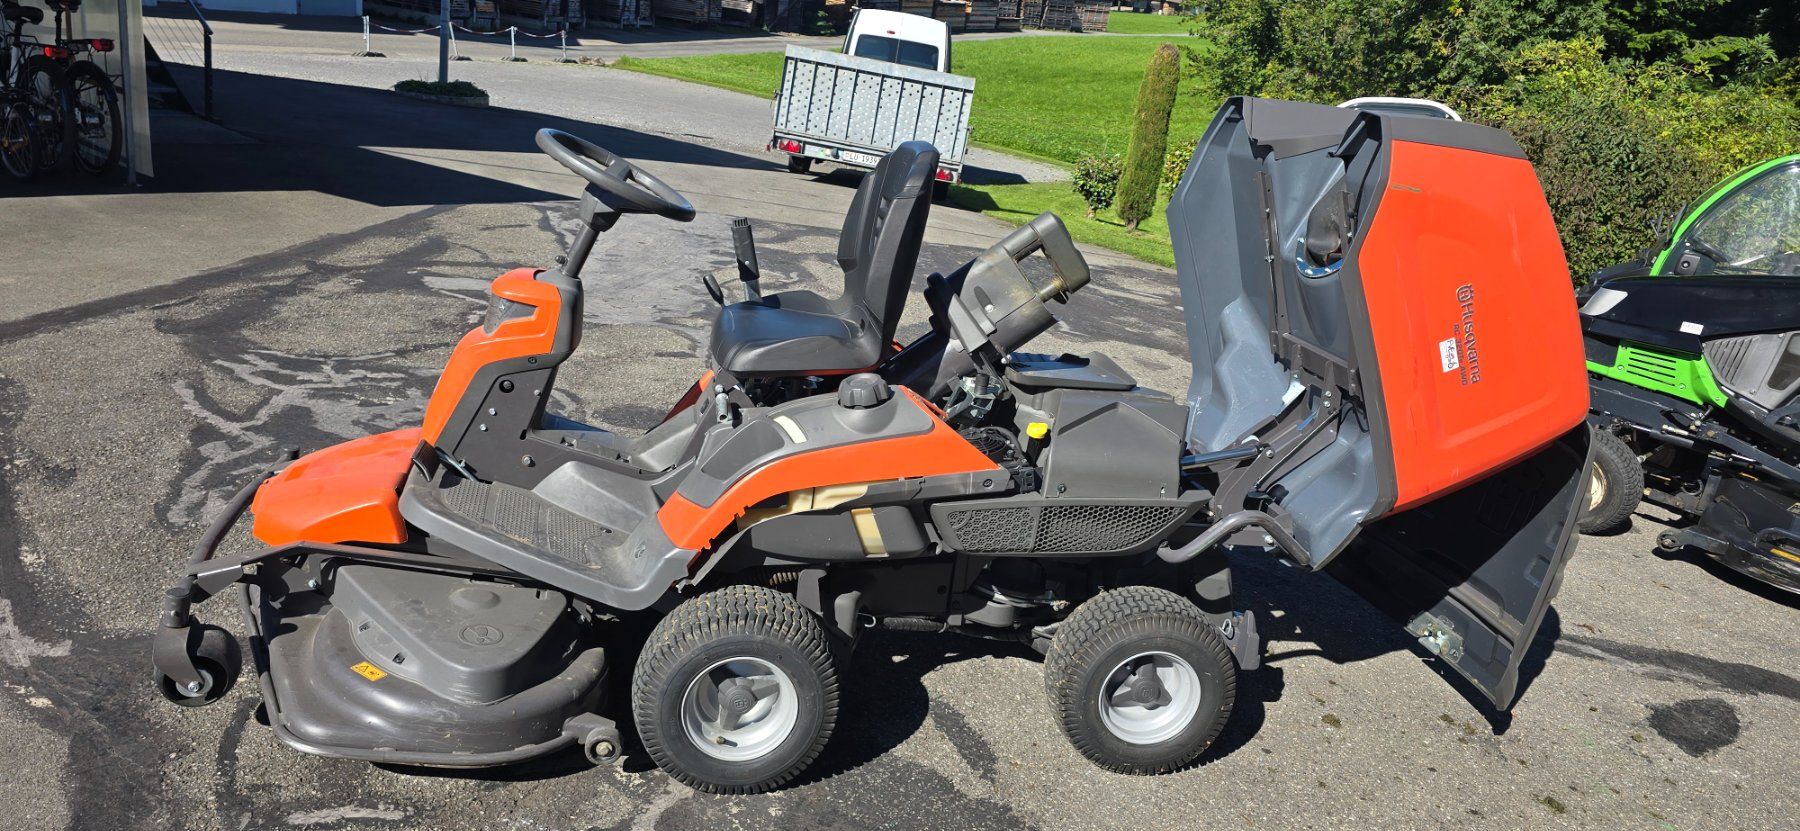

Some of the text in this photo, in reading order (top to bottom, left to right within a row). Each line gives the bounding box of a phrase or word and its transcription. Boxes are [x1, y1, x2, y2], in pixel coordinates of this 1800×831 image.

[1453, 323, 1461, 336] RC
[1459, 366, 1468, 386] AWD
[1461, 302, 1480, 384] Husqvarna
